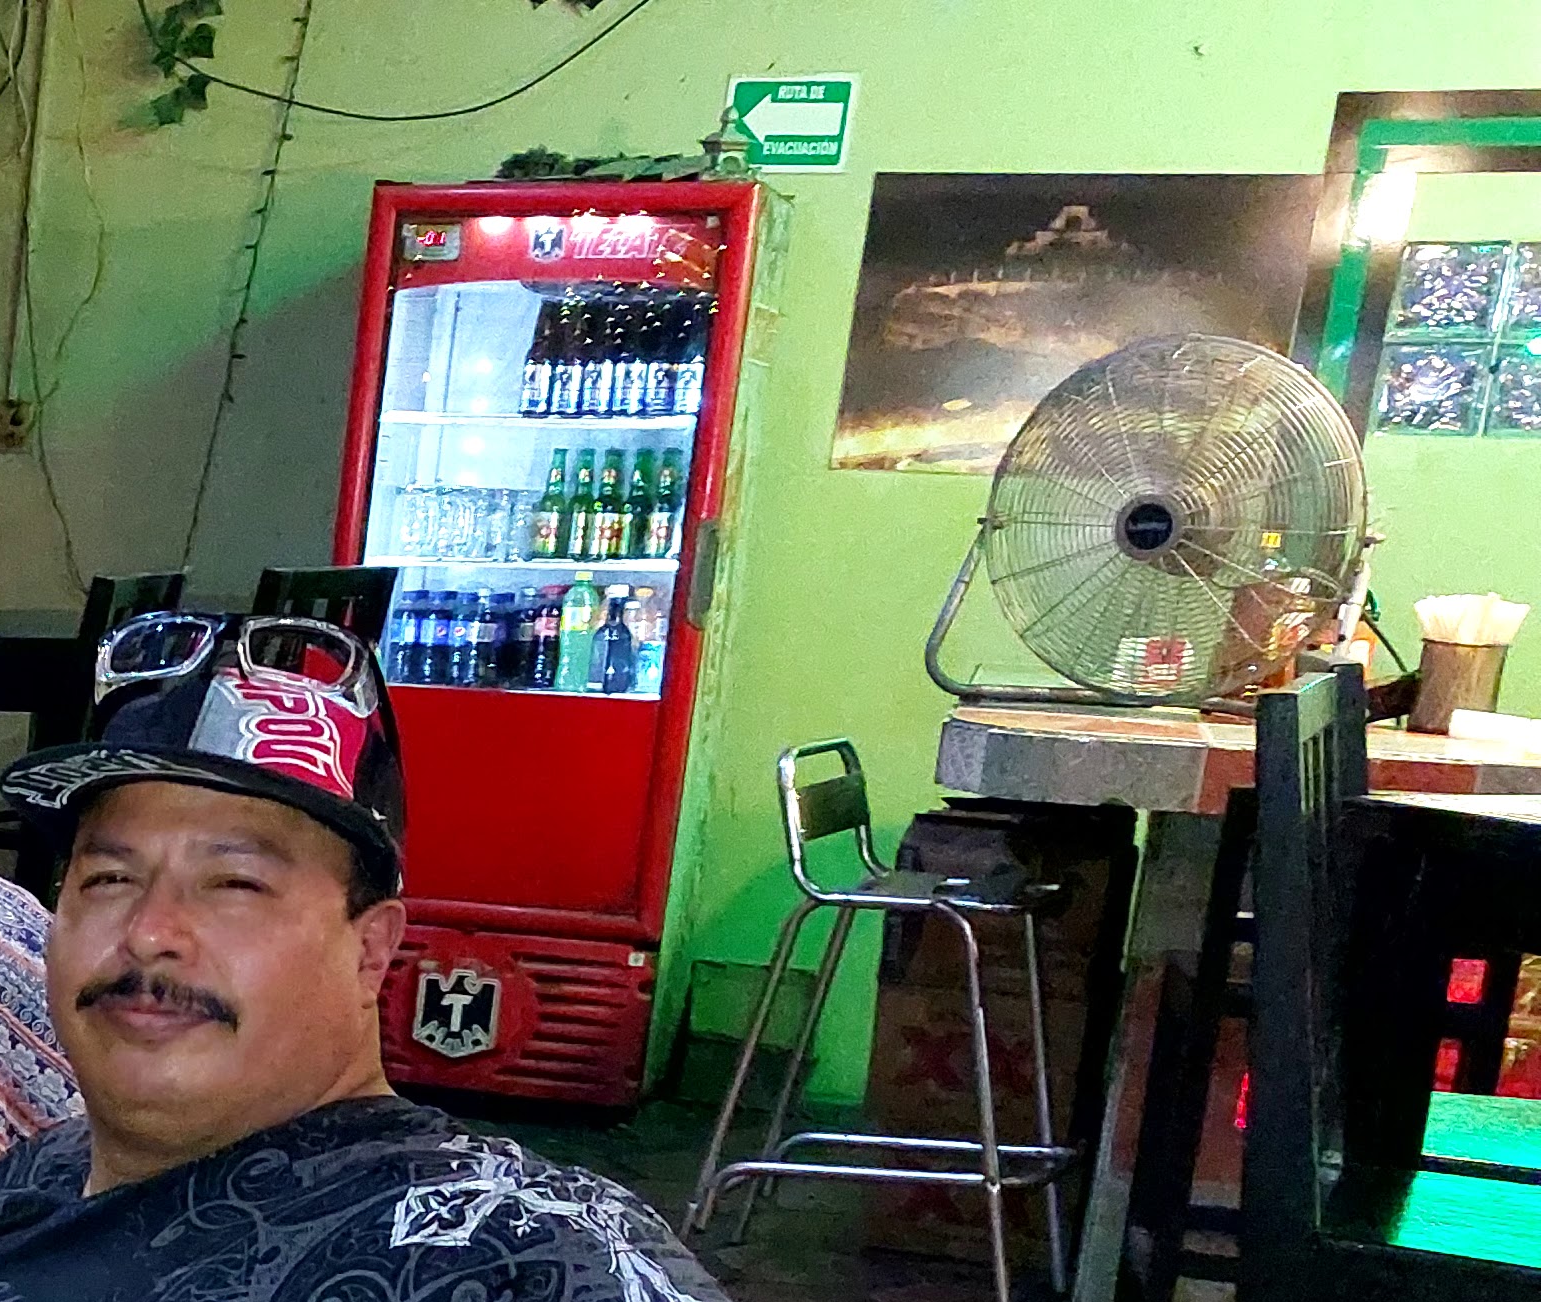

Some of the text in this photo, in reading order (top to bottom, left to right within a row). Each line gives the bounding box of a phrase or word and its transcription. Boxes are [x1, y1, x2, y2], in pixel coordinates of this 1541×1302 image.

[778, 85, 826, 99] RUTA DE
[763, 138, 839, 155] EVACUACIÓN
